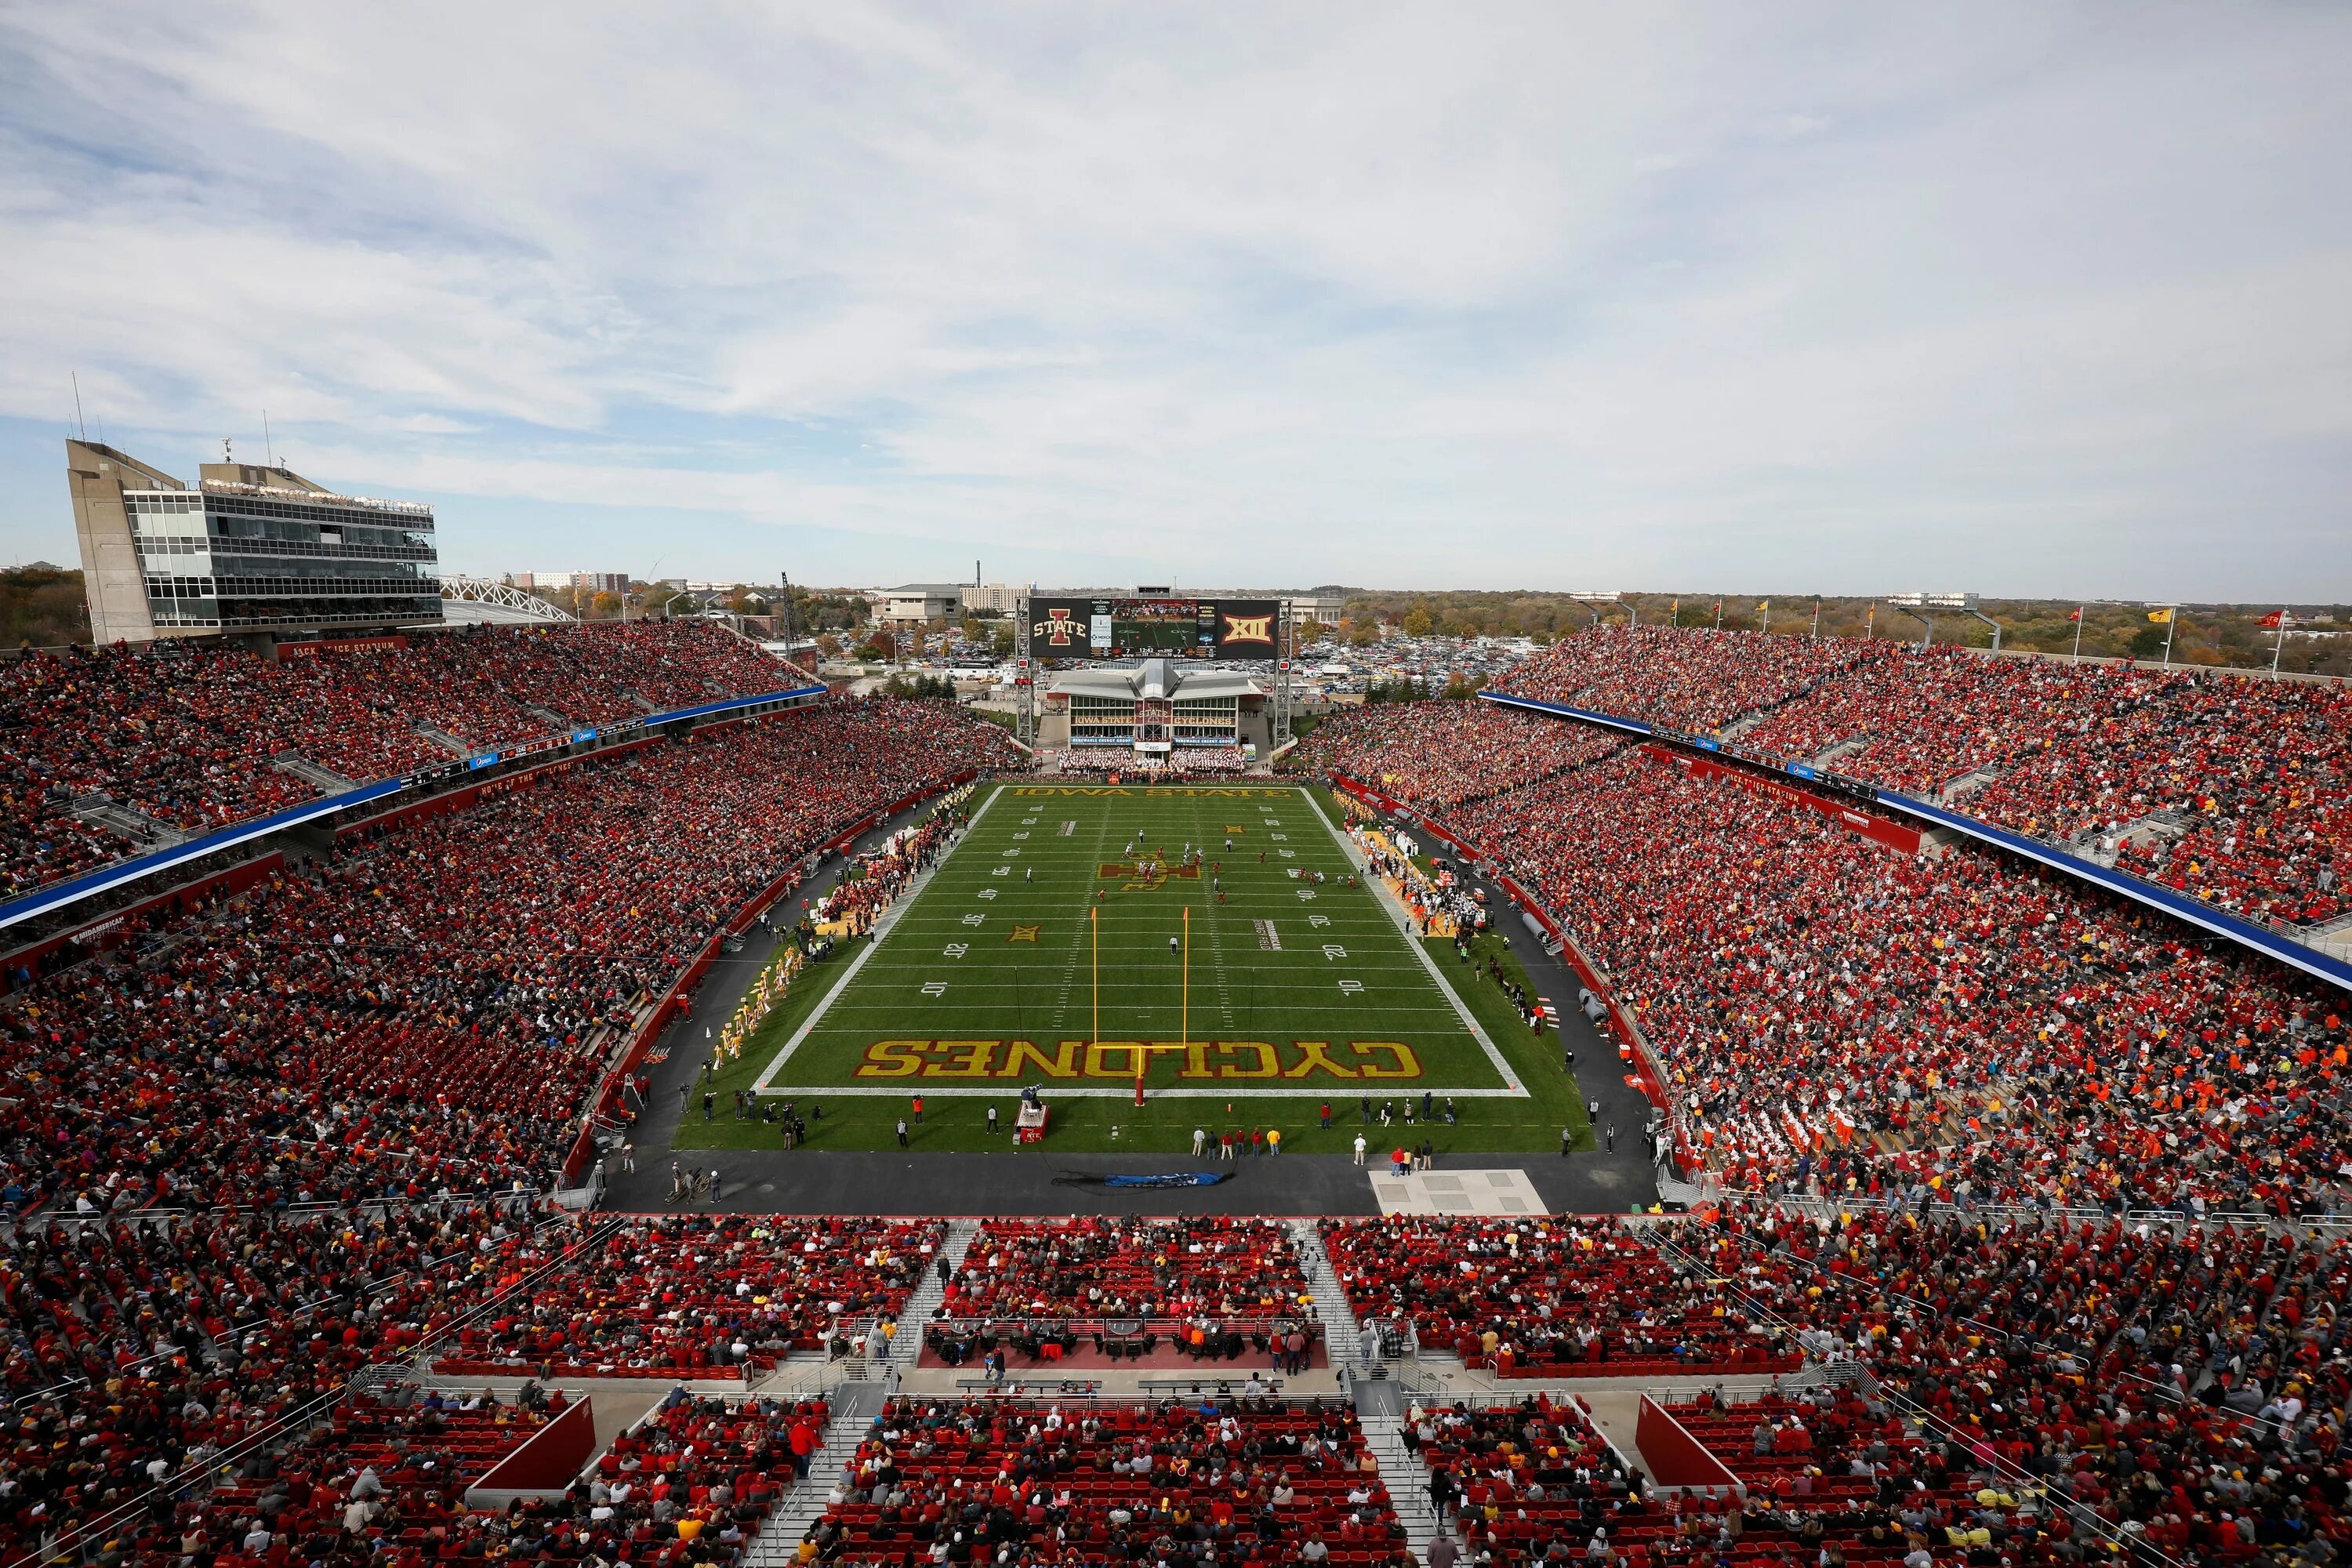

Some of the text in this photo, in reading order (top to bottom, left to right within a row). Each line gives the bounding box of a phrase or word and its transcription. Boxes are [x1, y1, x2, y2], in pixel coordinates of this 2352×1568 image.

[1033, 620, 1086, 637] STATE
[519, 774, 532, 783] THE
[1011, 788, 1134, 797] IOWA
[978, 889, 998, 898] 40
[1297, 890, 1317, 899] 40
[962, 913, 985, 924] 30
[1308, 915, 1330, 926] 30
[79, 916, 124, 939] MIDAMERICAN
[943, 943, 968, 955] 20
[1322, 945, 1347, 957] 20
[921, 982, 947, 993] 10
[1338, 980, 1365, 992] 10
[850, 1038, 1425, 1079] CYCLONES
